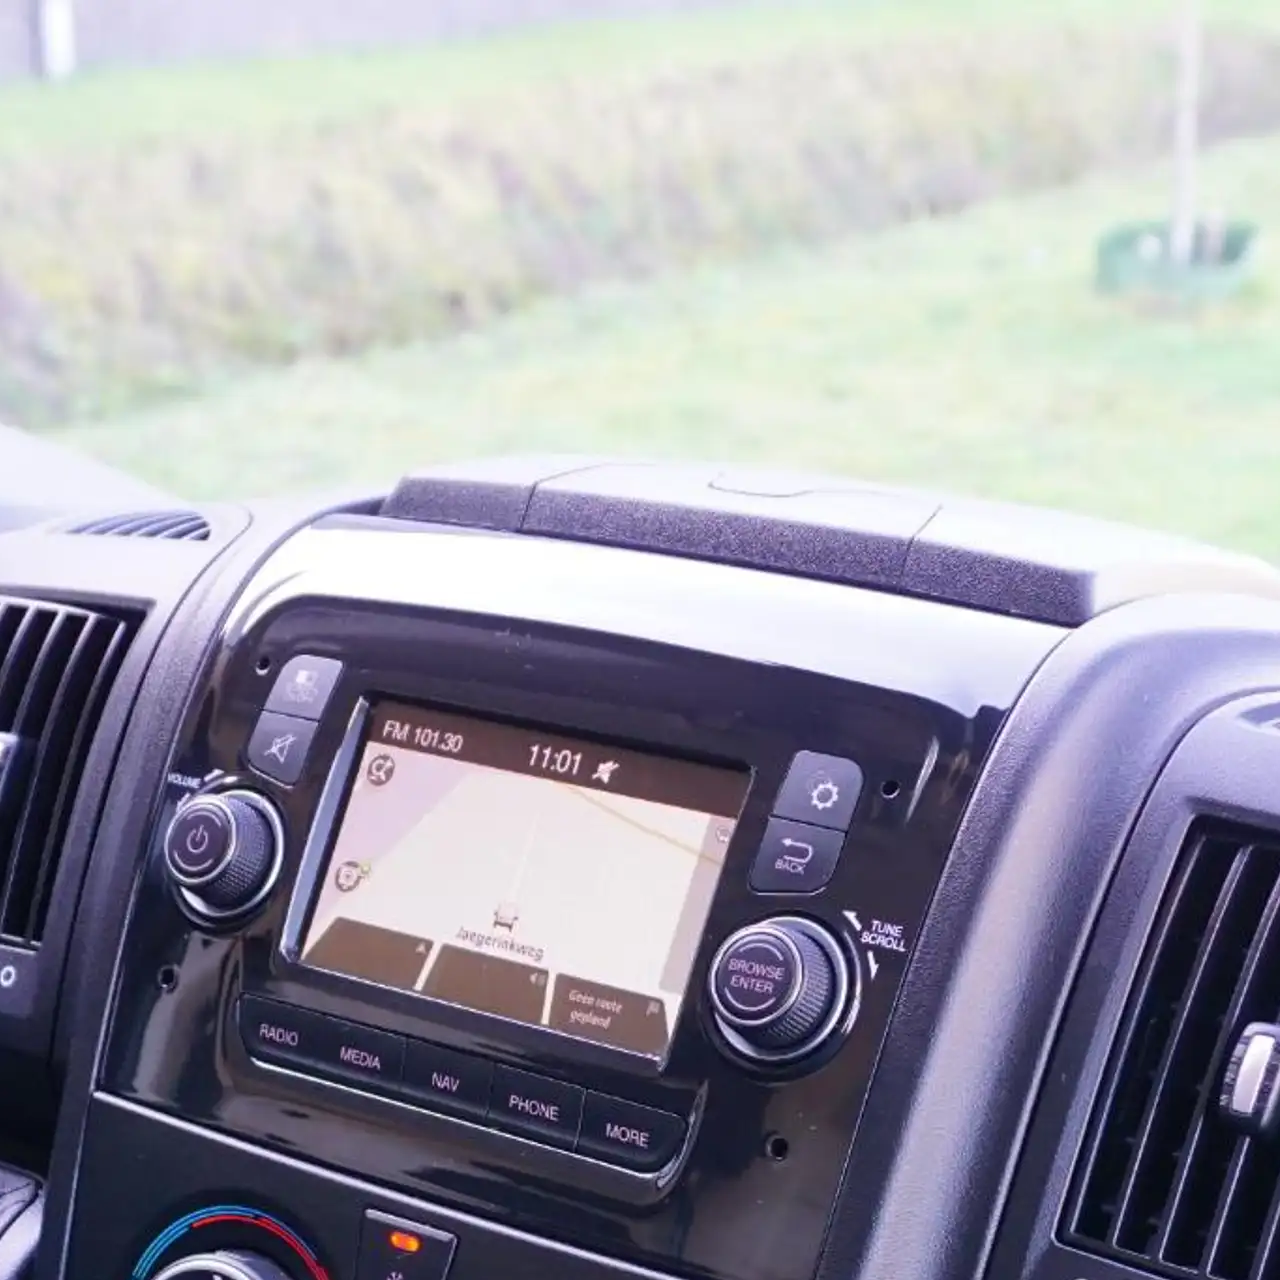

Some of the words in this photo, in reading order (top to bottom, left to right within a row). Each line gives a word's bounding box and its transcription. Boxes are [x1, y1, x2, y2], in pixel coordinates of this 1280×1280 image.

[382, 719, 409, 741] FM
[413, 727, 464, 752] 101.30
[528, 743, 583, 775] 11:01
[167, 772, 202, 789] VOLUME
[774, 859, 806, 875] BACK
[871, 920, 904, 937] TUNE
[861, 931, 907, 952] SCROLL
[728, 957, 786, 981] BROWSE
[730, 975, 775, 994] ENTER
[259, 1023, 299, 1047] RADIO
[339, 1046, 381, 1071] MEDIA
[431, 1071, 460, 1093] NAV
[508, 1094, 561, 1122] PHONE
[605, 1122, 651, 1149] MORE
